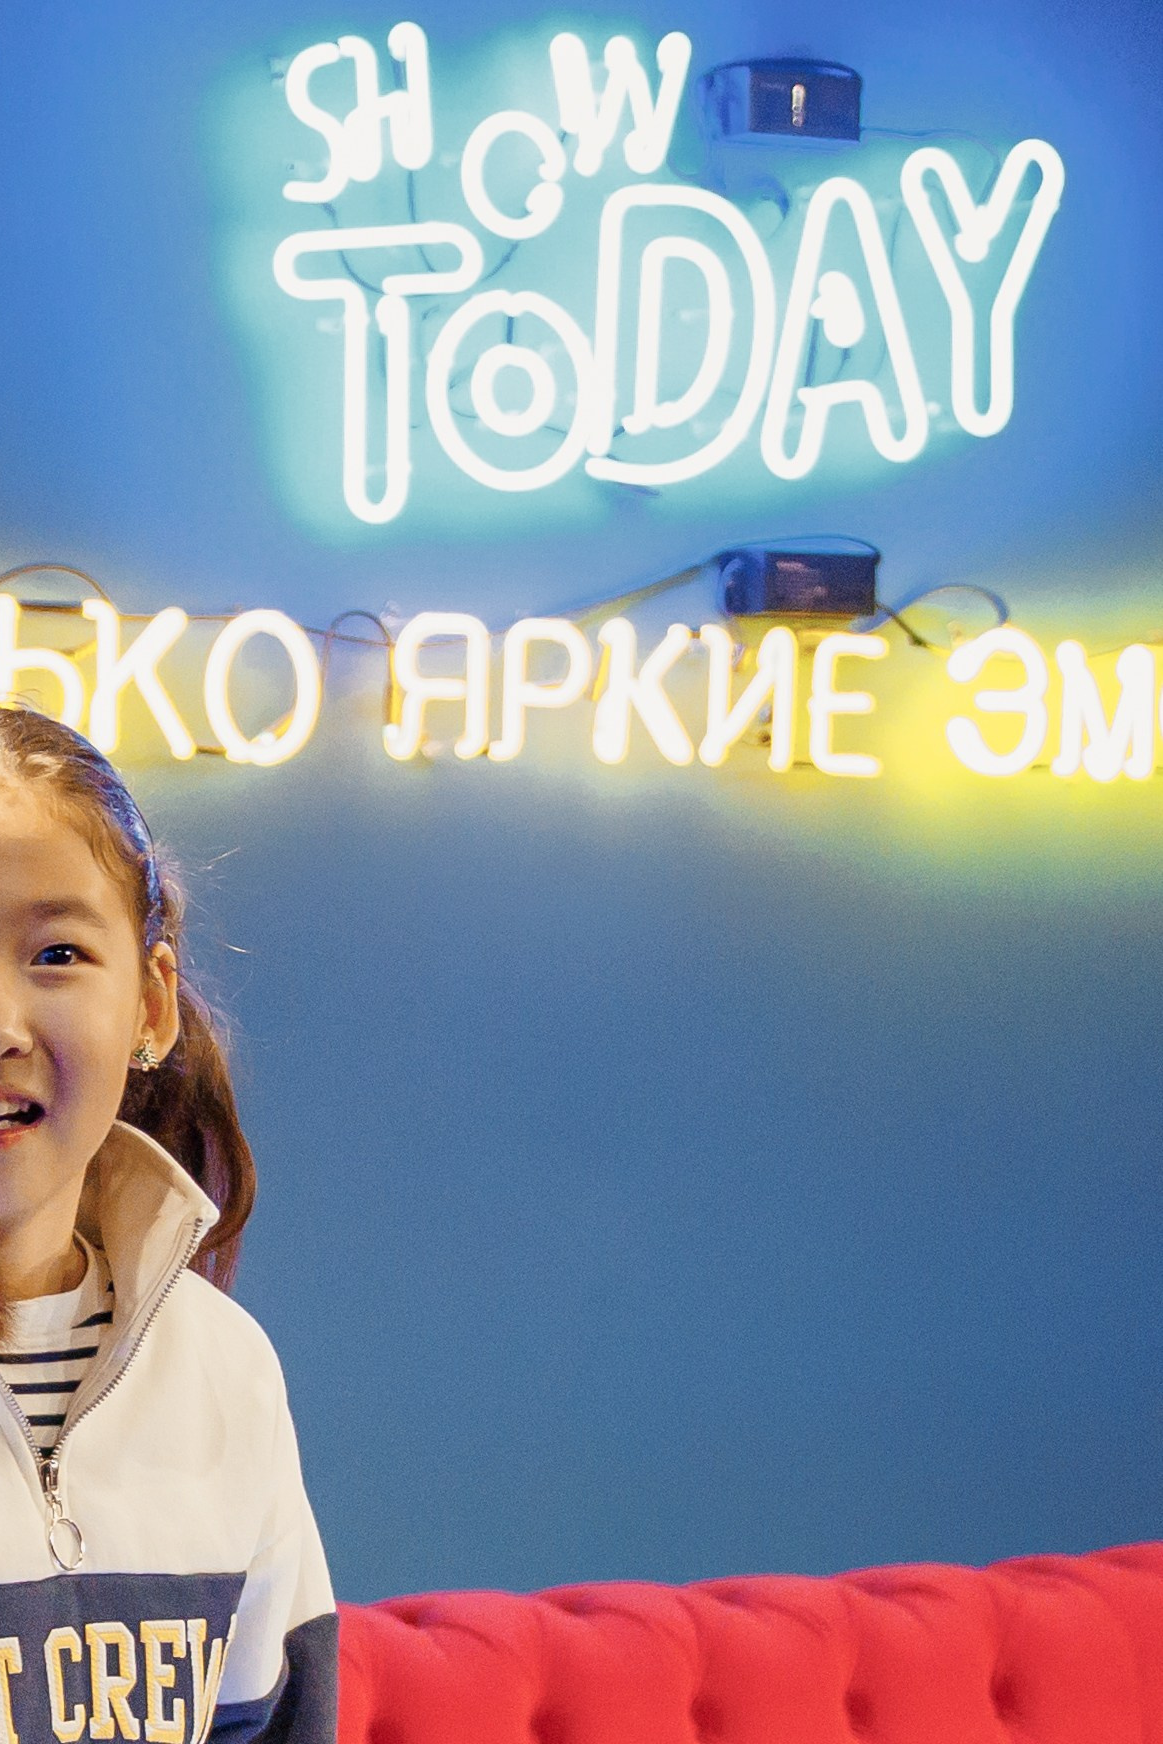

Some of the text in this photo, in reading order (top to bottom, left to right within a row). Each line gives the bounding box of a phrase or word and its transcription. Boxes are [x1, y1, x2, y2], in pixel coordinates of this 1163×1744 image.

[283, 21, 692, 239] SHOW
[383, 611, 883, 777] ЯРКИЕ
[945, 626, 1163, 782] ЭМ
